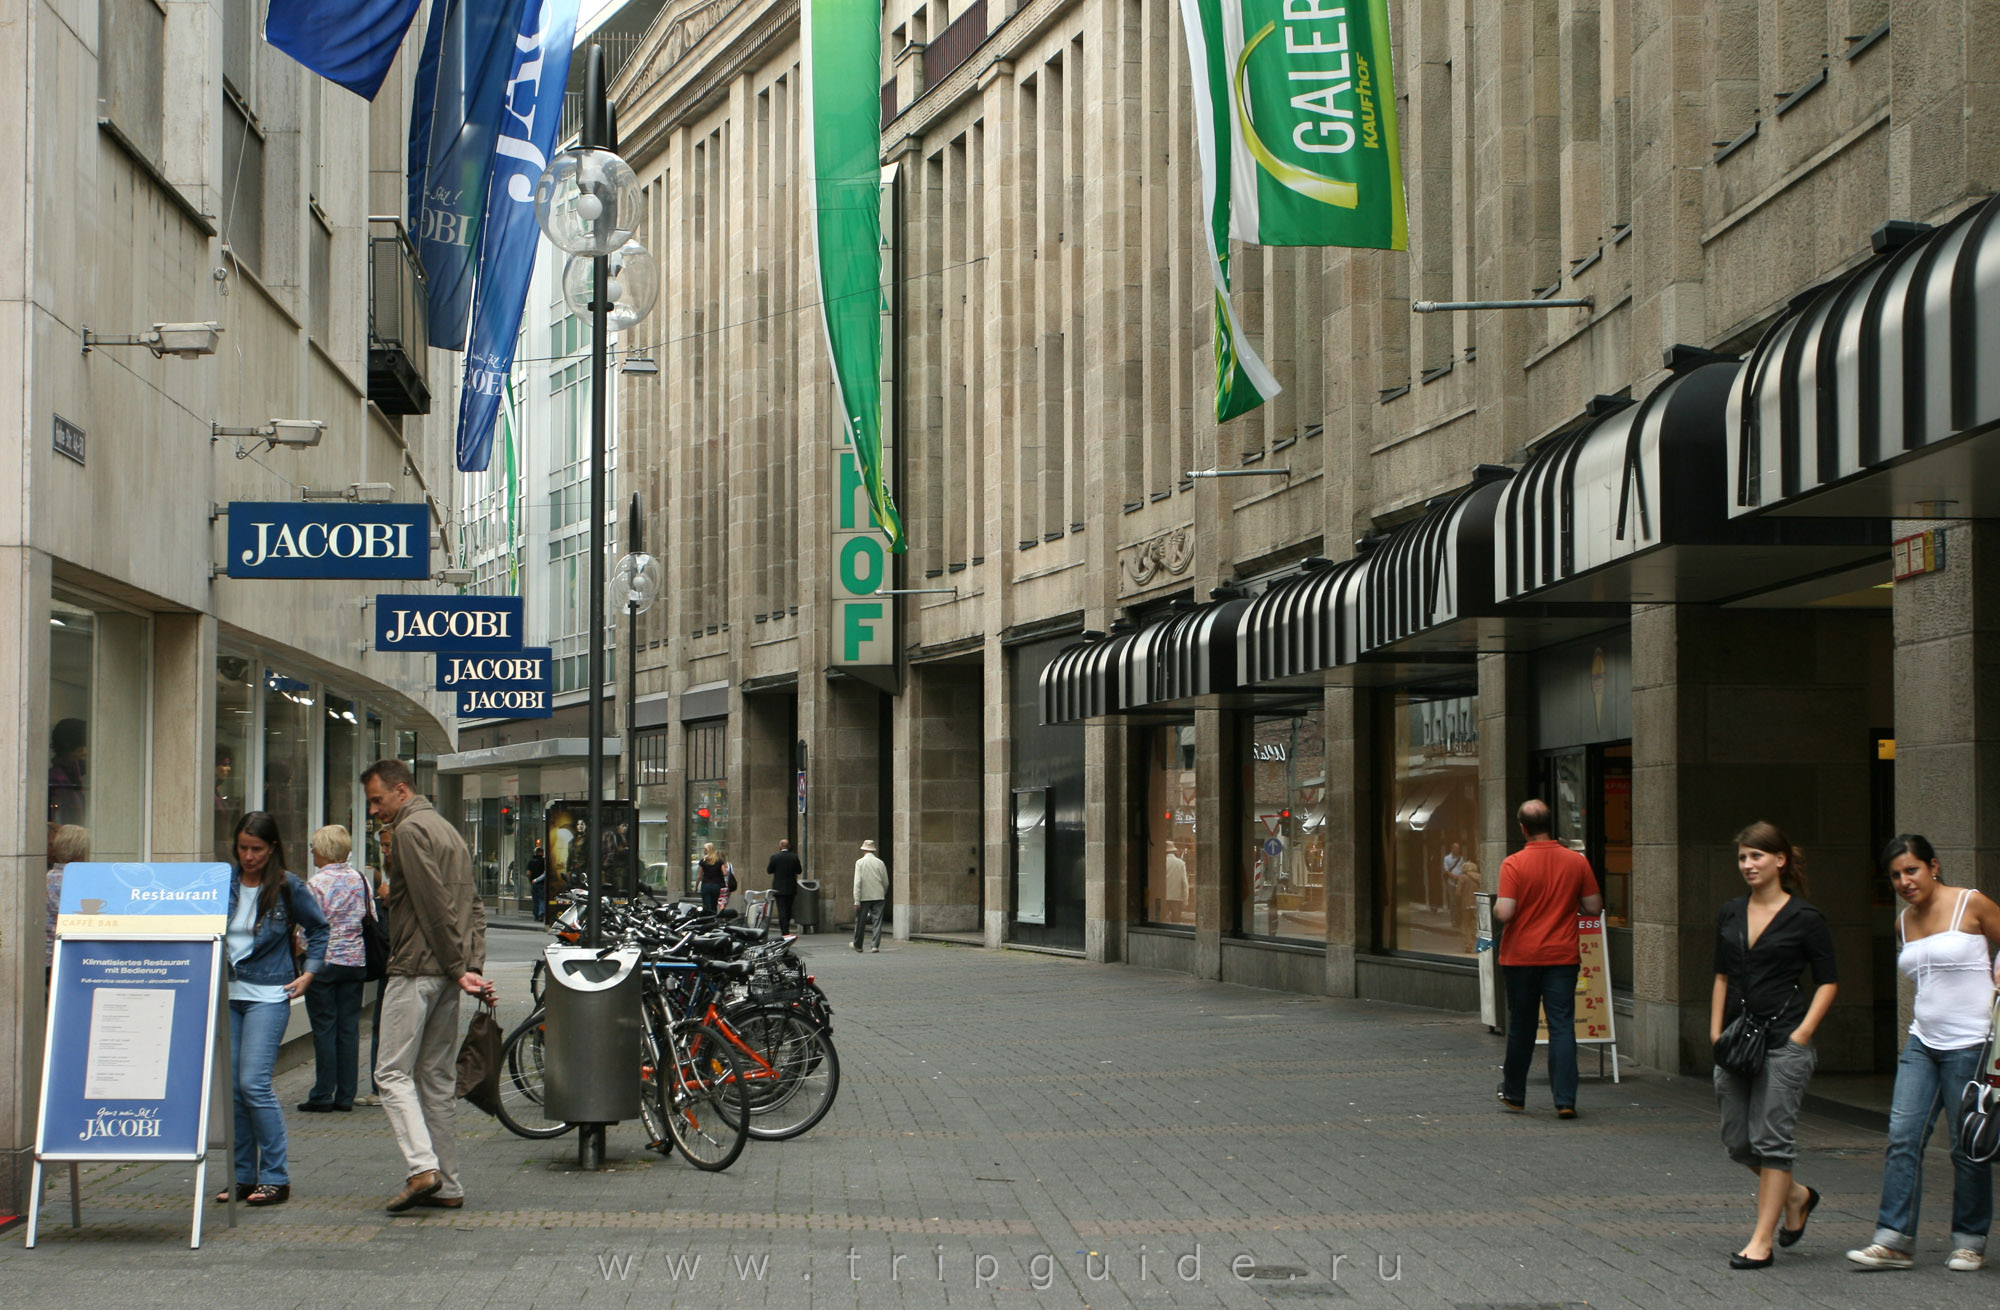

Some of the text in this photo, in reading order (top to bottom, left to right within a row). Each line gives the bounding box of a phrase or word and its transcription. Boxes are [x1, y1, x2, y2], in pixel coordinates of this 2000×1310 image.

[241, 522, 414, 567] JACOBI
[385, 609, 513, 643] JACOBI
[444, 658, 545, 685] JACOBI
[463, 690, 546, 713] JACOBI
[131, 888, 218, 901] Restaurant
[98, 919, 119, 928] BAR
[82, 958, 190, 967] Klimatisiertes Restaurant
[104, 966, 168, 975] mit Bedienung
[79, 1118, 163, 1141] JACOBI
